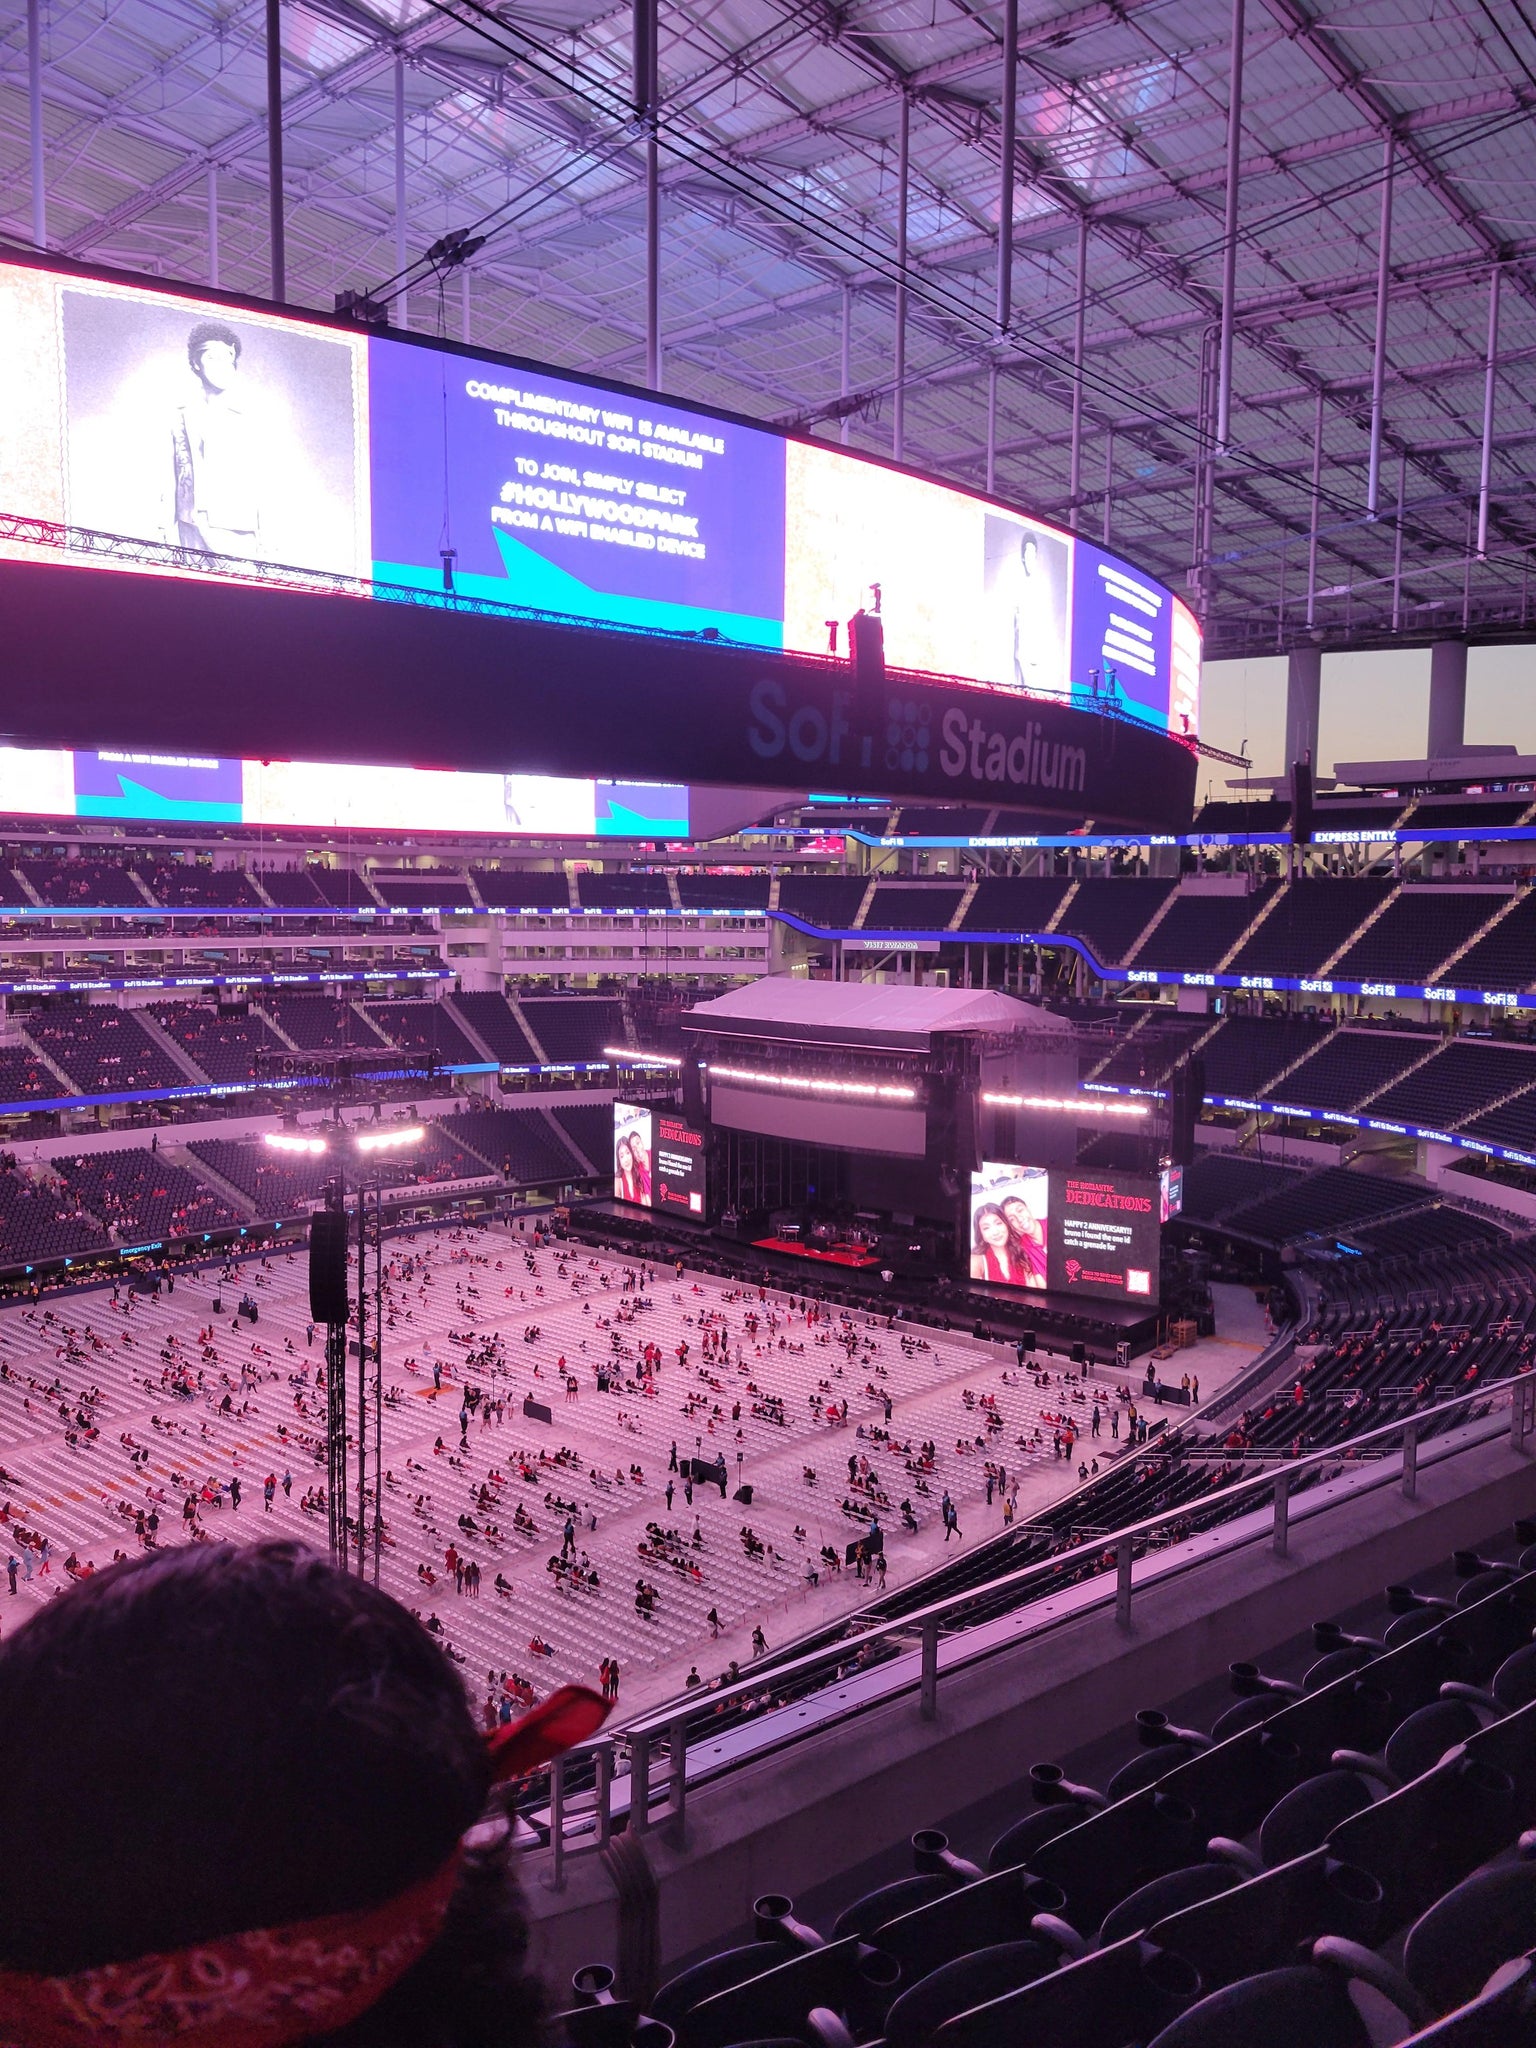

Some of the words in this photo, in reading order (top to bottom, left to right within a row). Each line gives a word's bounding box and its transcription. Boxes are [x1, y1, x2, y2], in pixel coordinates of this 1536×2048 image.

[465, 380, 600, 424] COMPLIMENTARY
[601, 409, 633, 432] WIFI
[638, 419, 653, 437] IS
[653, 423, 725, 454] AVAILABLE
[494, 408, 606, 446] THROUGHOUT
[606, 433, 641, 455] SOFI
[642, 442, 703, 469] STADIUM
[515, 457, 538, 477] TO
[540, 462, 581, 487] JOIN,
[582, 471, 634, 495] SIMPLY
[635, 481, 687, 506] SELECT
[500, 481, 699, 537] #HOLLYWOODPARK
[491, 506, 538, 529] FROM
[540, 516, 554, 532] A
[554, 517, 588, 537] WIFI
[589, 523, 655, 550] ENABLED
[656, 536, 706, 559] DEVICE
[940, 707, 1086, 792] Stadium
[880, 837, 896, 846] SoFi
[968, 837, 1007, 847] EXPRESS
[1150, 835, 1167, 845] SoFi
[1315, 832, 1360, 843] EXPRESS
[1360, 830, 1397, 842] ENTRY.
[864, 941, 882, 949] VISIT
[885, 941, 918, 950] RWANDA
[1128, 971, 1147, 982] SoFi
[1183, 973, 1204, 985] SoFi
[1241, 976, 1262, 988] SoFi
[1300, 980, 1321, 992] SoFi
[1361, 983, 1384, 996] SoFi
[1424, 988, 1445, 1000] SoFi
[1484, 992, 1506, 1005] SoFi
[1342, 1115, 1359, 1125] Stadium
[1435, 1132, 1452, 1143] Stadium
[1066, 1180, 1079, 1189] THE
[1080, 1182, 1114, 1193] ROMANTIC
[1066, 1189, 1152, 1212] DEDICATIONS
[1064, 1219, 1083, 1229] HAPPY
[1064, 1228, 1080, 1237] bruno
[1085, 1231, 1101, 1240] found
[1102, 1233, 1111, 1241] the
[1124, 1236, 1131, 1244] id
[121, 1244, 150, 1255] Emergency
[1083, 1242, 1106, 1250] grenade
